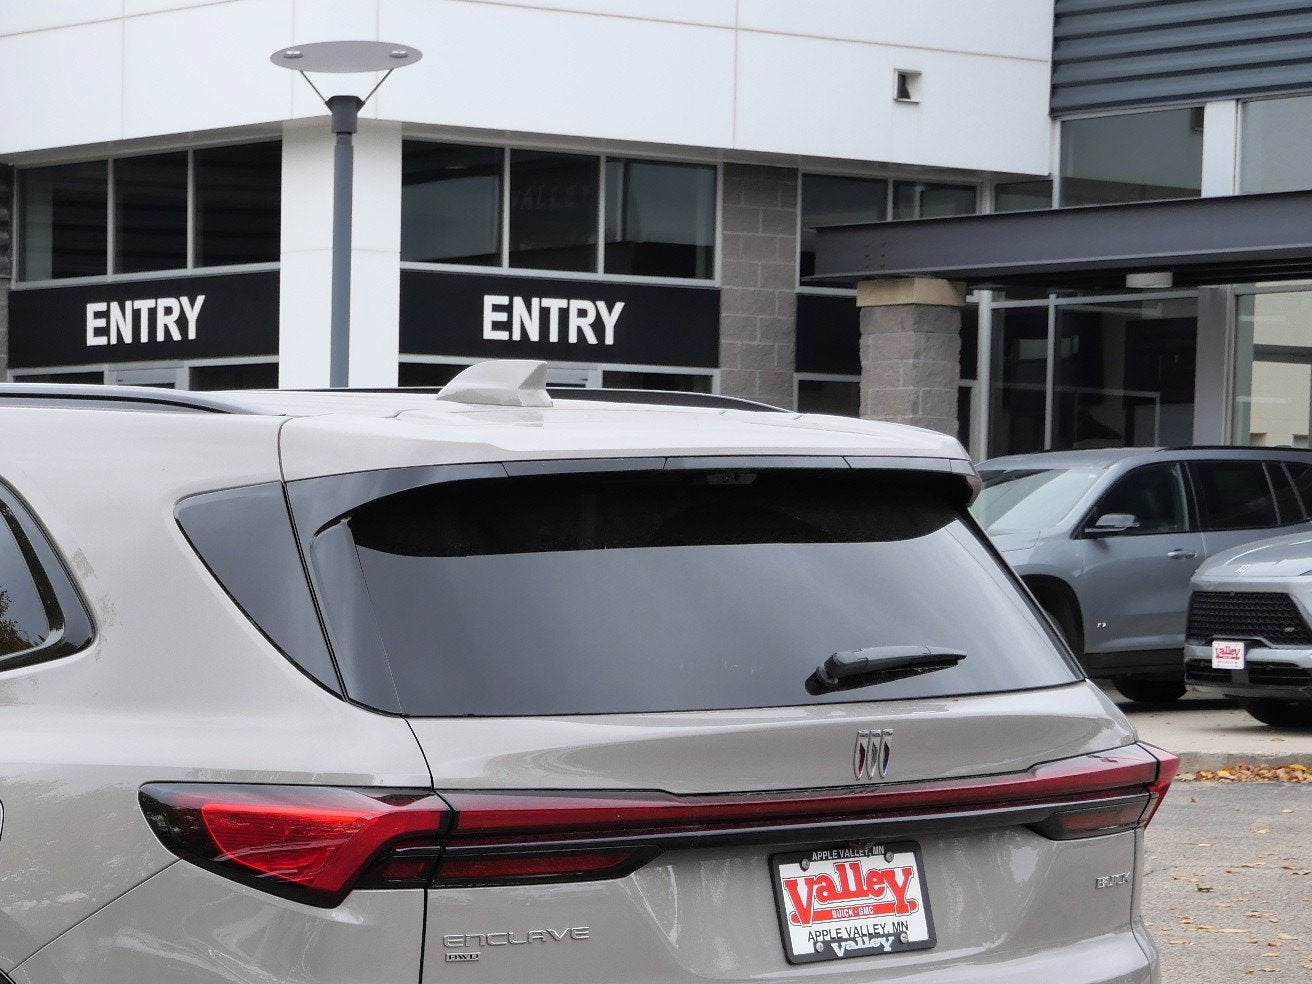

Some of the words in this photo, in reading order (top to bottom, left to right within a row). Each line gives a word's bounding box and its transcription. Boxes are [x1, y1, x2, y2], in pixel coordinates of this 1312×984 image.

[85, 294, 206, 347] ENTRY
[482, 294, 625, 346] ENTRY
[812, 850, 838, 862] APPLE
[872, 845, 885, 855] MN
[831, 906, 854, 919] BUICK
[858, 905, 874, 917] GMC
[443, 926, 590, 948] ENCLAVE
[807, 928, 843, 943] APPLE
[892, 920, 909, 934] MN
[447, 952, 480, 961] AWD
